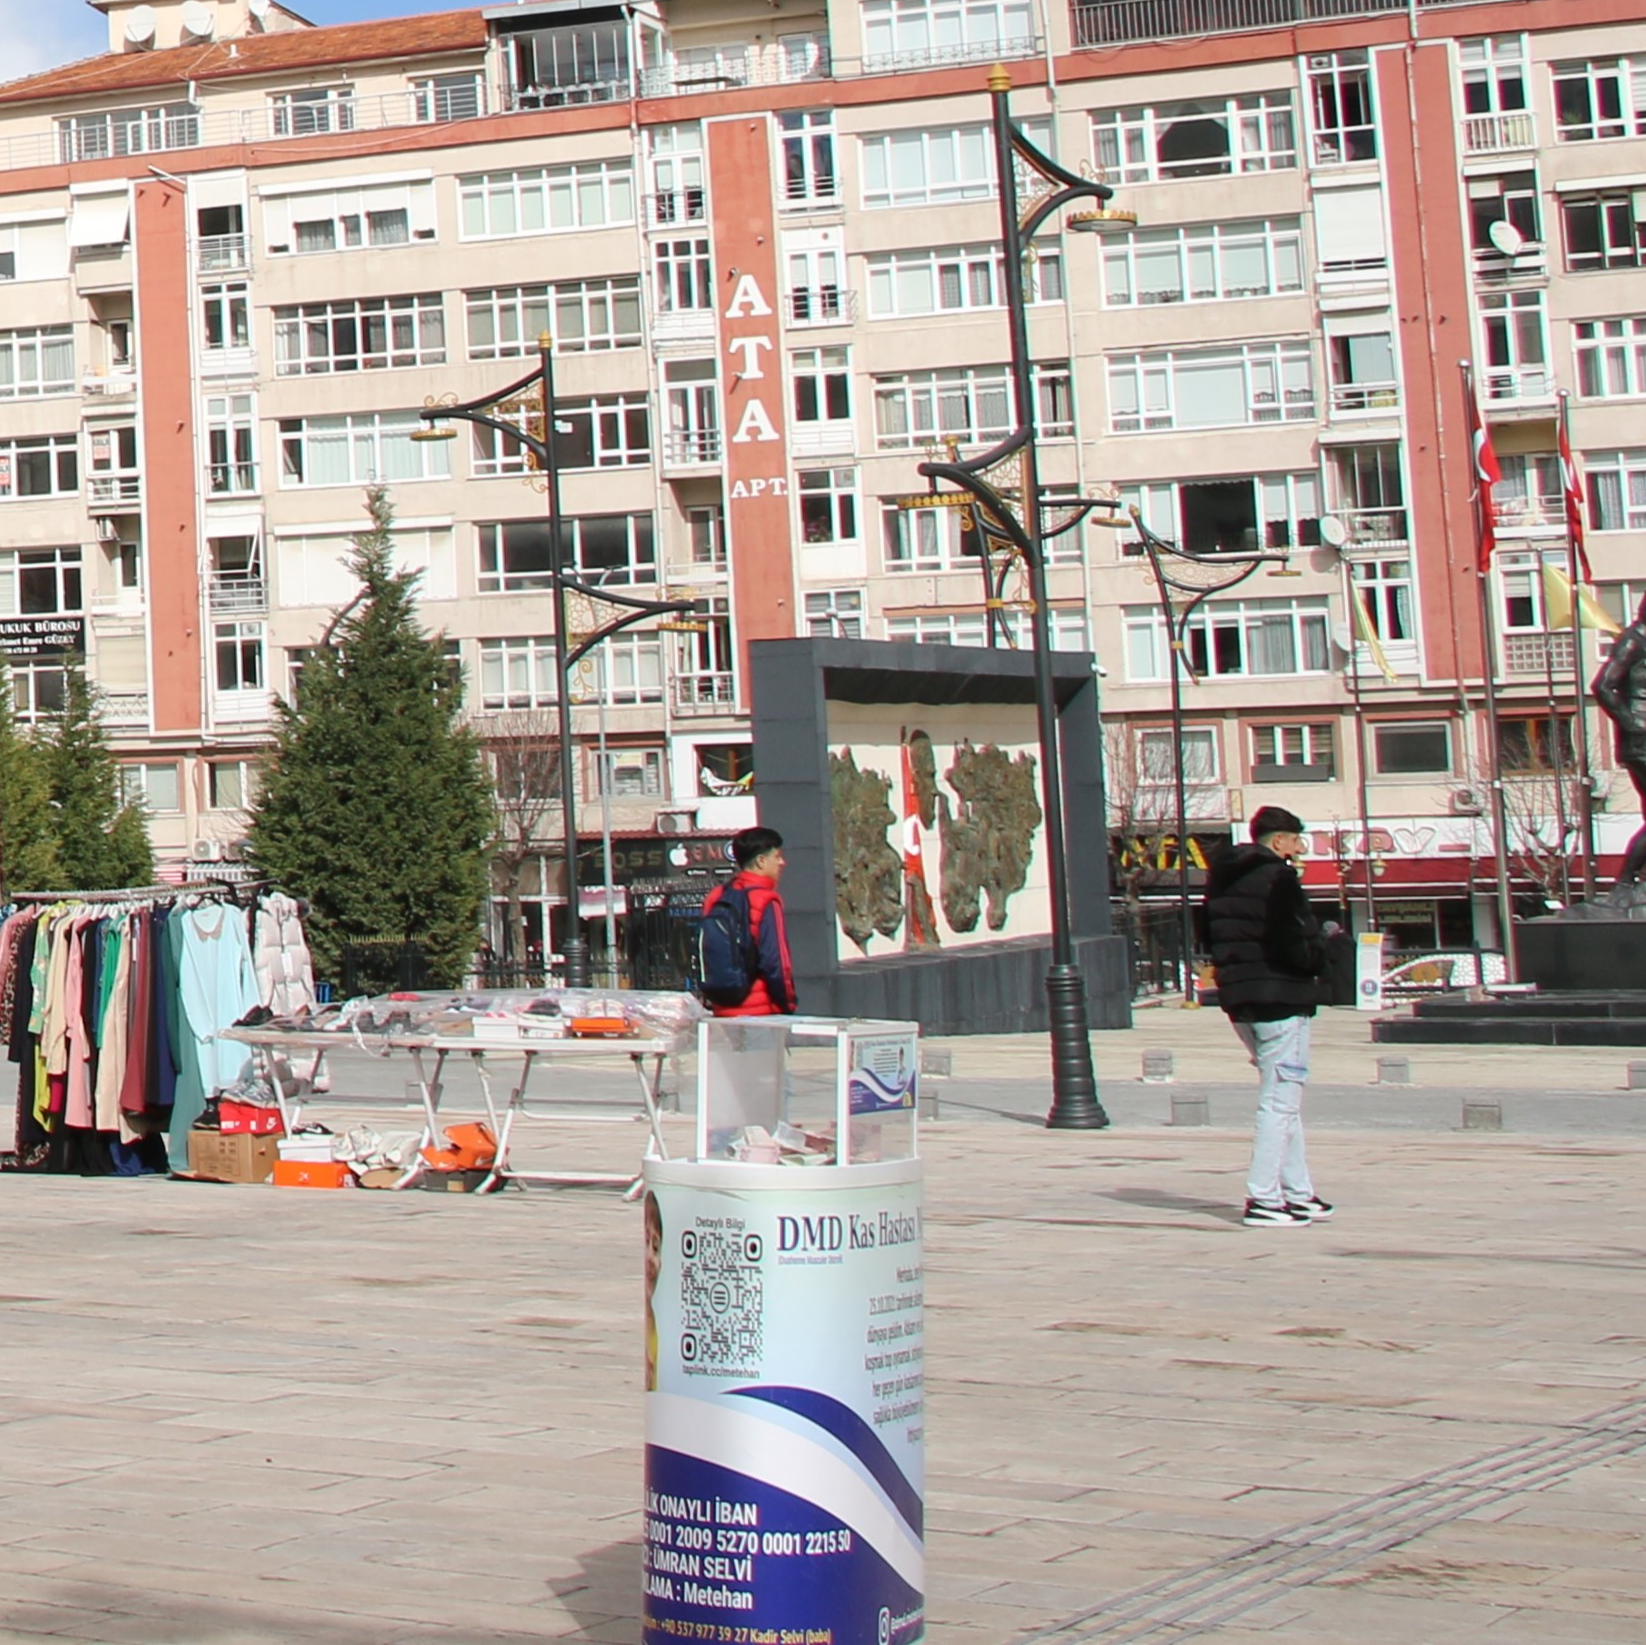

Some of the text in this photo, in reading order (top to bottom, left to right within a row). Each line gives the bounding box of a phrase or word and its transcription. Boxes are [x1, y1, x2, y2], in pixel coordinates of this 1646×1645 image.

[724, 273, 781, 443] ATA
[730, 477, 788, 499] APT.
[34, 620, 81, 633] BÜROSU
[695, 1216, 746, 1231] Detaylı Bilgi
[776, 1215, 843, 1252] DMD
[848, 1213, 876, 1250] Kas
[660, 1494, 711, 1522] ONAYLI
[715, 1496, 757, 1526] İBAN
[675, 1524, 713, 1551] 2009
[716, 1529, 759, 1555] 5270
[762, 1532, 802, 1556] 0001
[805, 1531, 837, 1554] 2215
[837, 1529, 852, 1552] 50
[703, 1554, 753, 1582] SELVİ
[683, 1581, 754, 1610] Metehan
[676, 1620, 695, 1638] 537
[695, 1623, 716, 1640] 977
[717, 1625, 732, 1641] 39
[734, 1627, 749, 1643] 27
[749, 1627, 779, 1644] Kadir
[780, 1628, 805, 1645] Selvi
